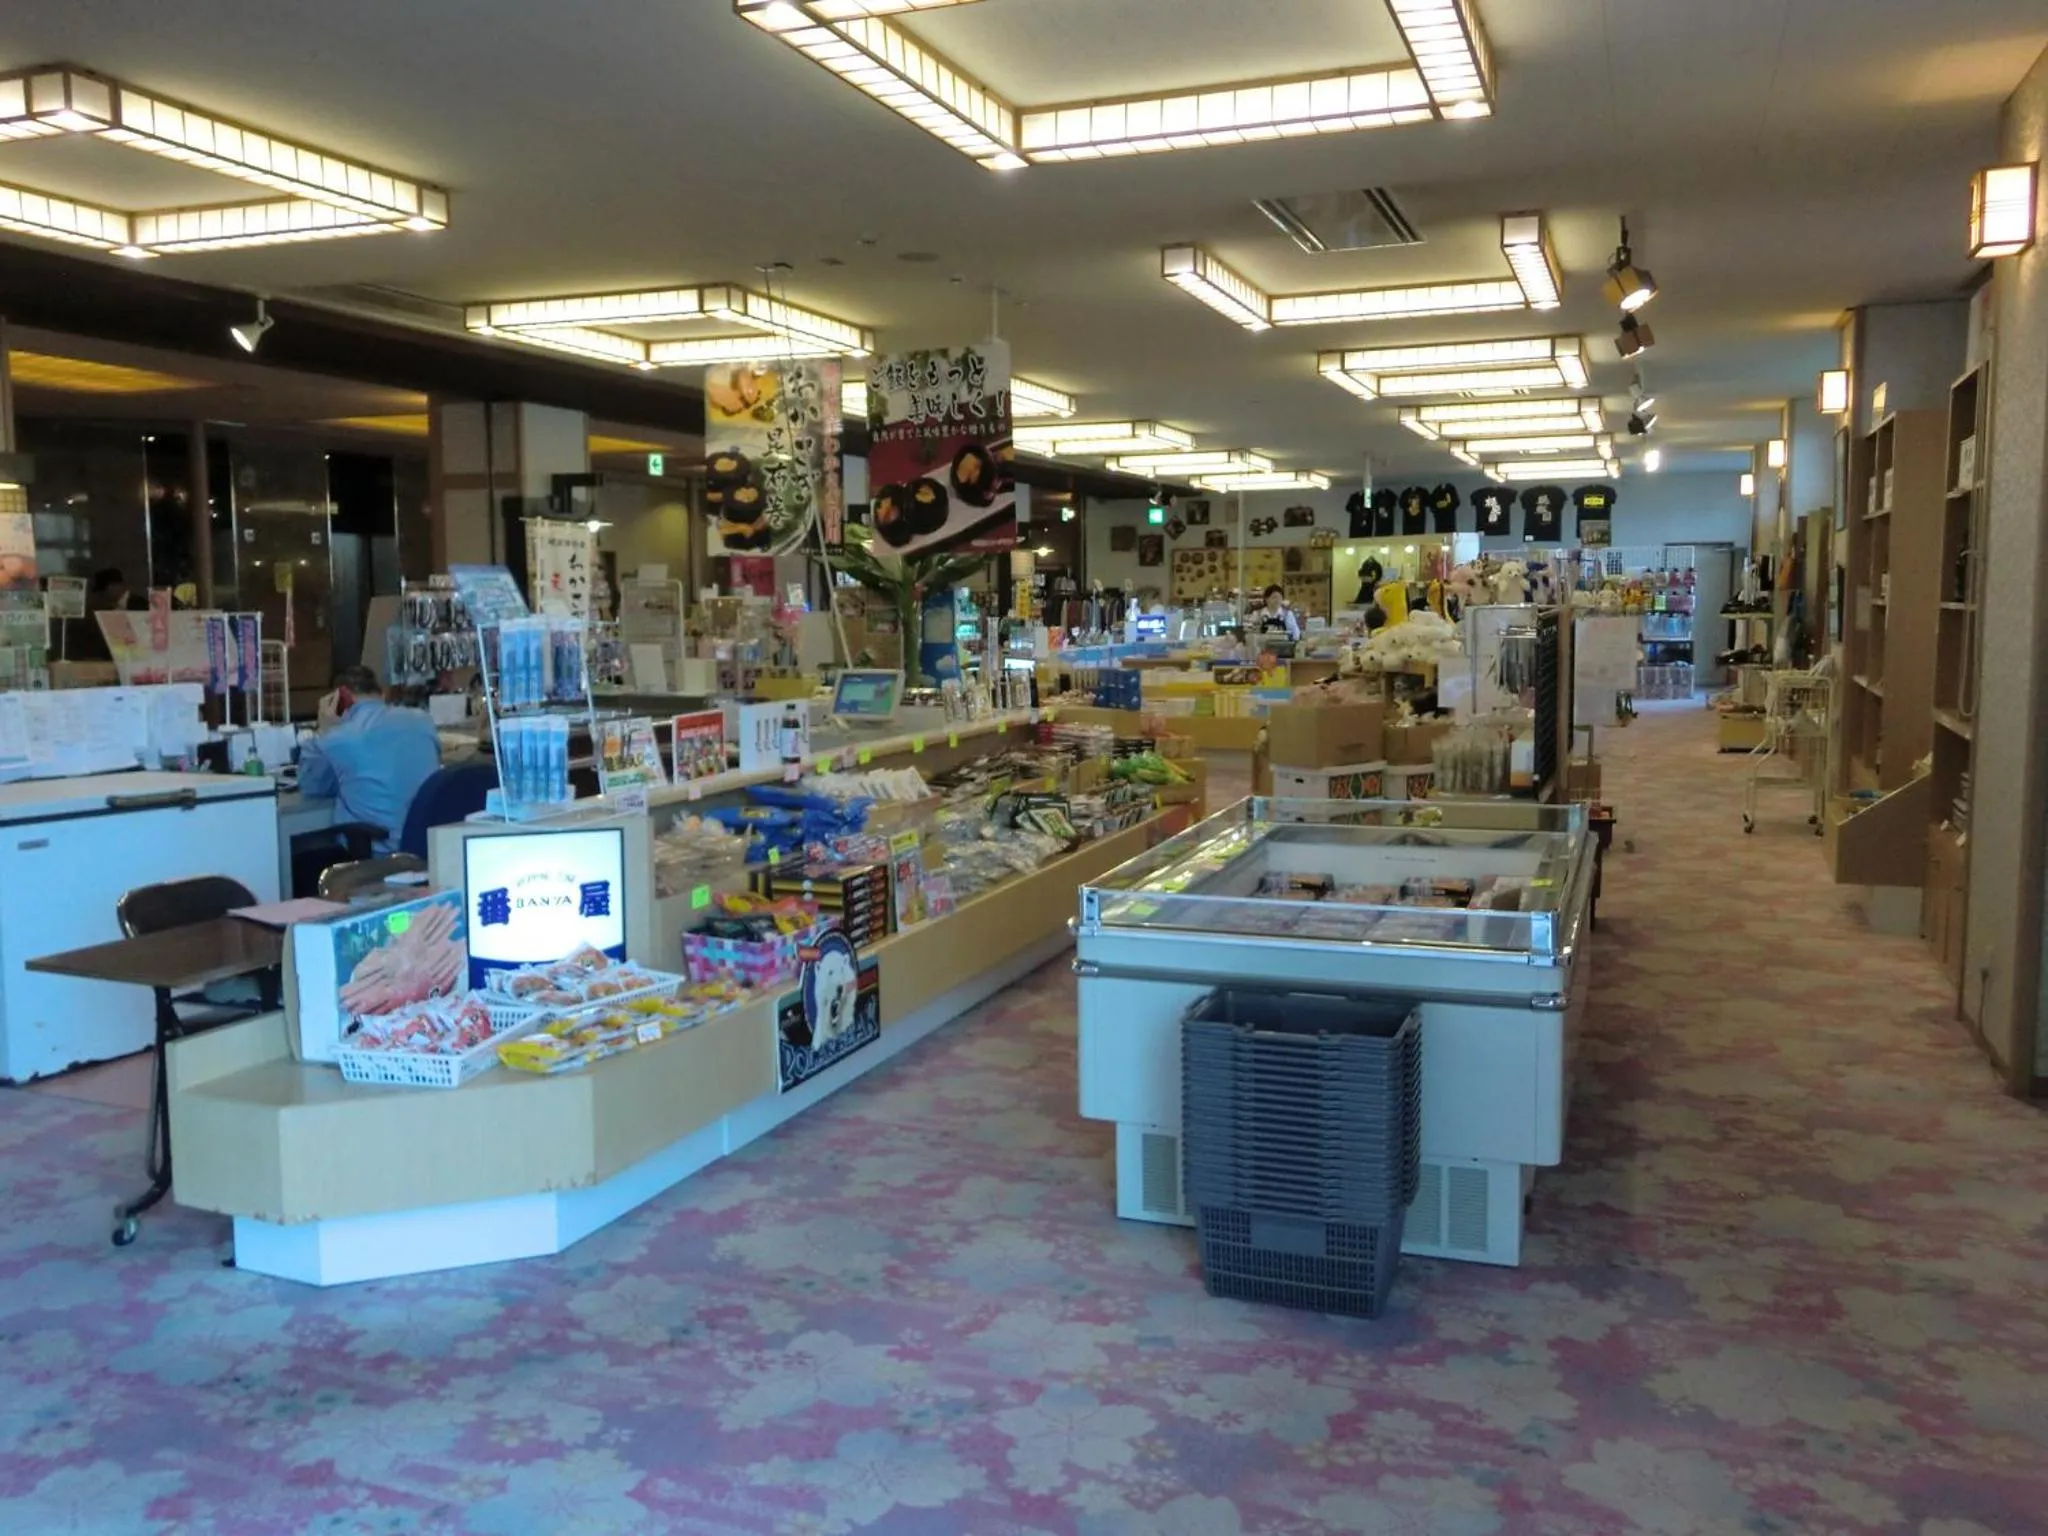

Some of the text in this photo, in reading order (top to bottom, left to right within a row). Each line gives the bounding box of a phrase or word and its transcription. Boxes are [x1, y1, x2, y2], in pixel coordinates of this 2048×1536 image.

[870, 354, 986, 391] ご飯をもっと
[762, 428, 791, 529] 昆布巻
[478, 880, 611, 926] 番 BANYA 屋
